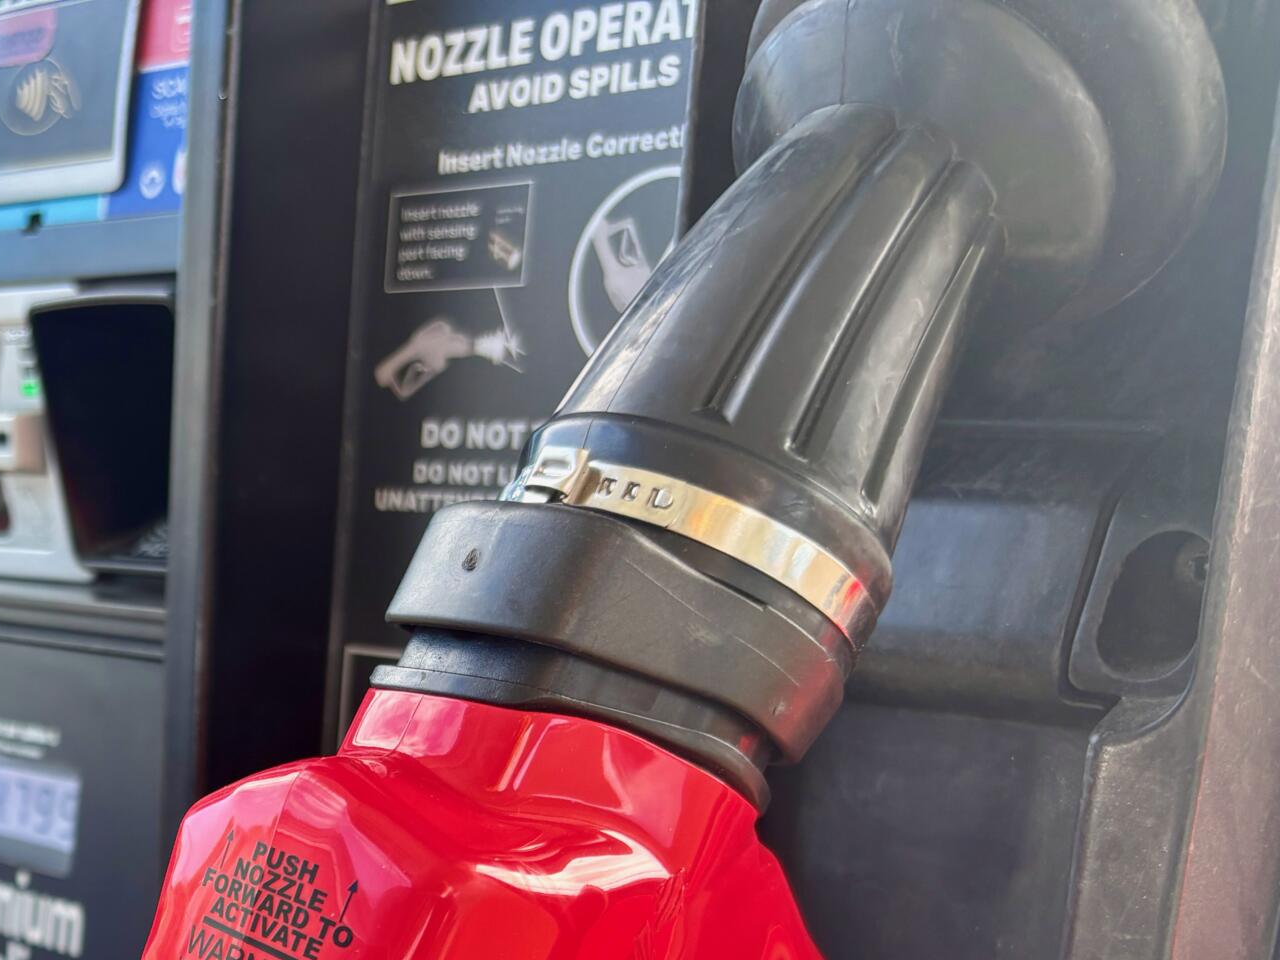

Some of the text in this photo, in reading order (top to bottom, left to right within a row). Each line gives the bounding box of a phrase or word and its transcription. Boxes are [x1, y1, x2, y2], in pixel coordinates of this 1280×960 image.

[390, 18, 536, 85] NOZZLE
[469, 55, 681, 114] AVOID SPILLS
[439, 147, 504, 175] Insert
[507, 138, 582, 167] Nozzle
[401, 206, 437, 222] Insert
[438, 203, 480, 219] nozzle
[400, 227, 426, 242] with
[422, 421, 526, 450] DO NOT
[413, 461, 444, 484] DO
[448, 462, 494, 485] NOT
[253, 841, 319, 884] PUSH
[234, 857, 328, 912] NOZZLE
[202, 867, 353, 948] FORWARD TO
[211, 897, 323, 960] ACTIVATE
